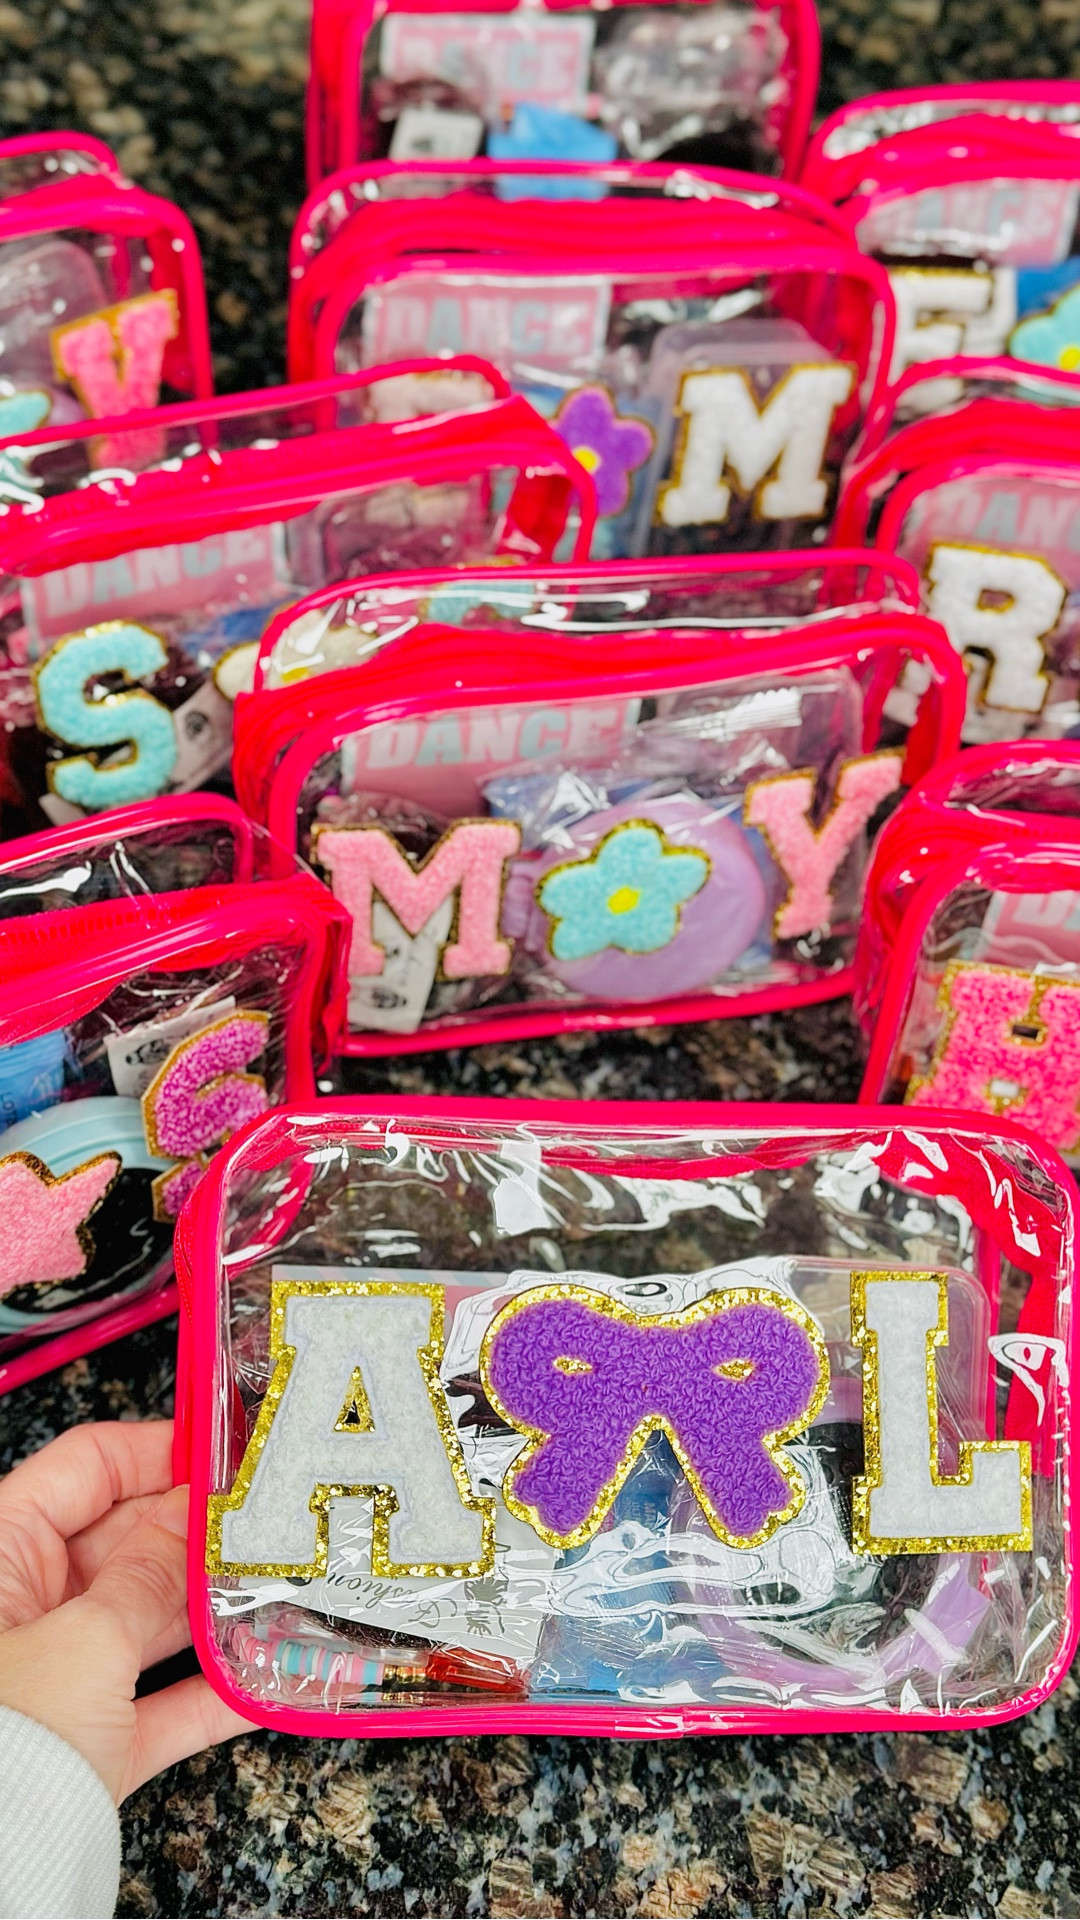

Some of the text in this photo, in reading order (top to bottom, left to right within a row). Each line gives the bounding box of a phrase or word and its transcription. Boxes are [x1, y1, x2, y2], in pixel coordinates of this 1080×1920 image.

[384, 294, 588, 357] DANCE
[653, 361, 857, 527] M
[43, 530, 266, 618] DANCE
[925, 540, 1070, 714] R
[30, 619, 178, 808] S
[366, 706, 618, 769] DANCE
[312, 747, 907, 980] M Y
[205, 1271, 1033, 1577] A L
